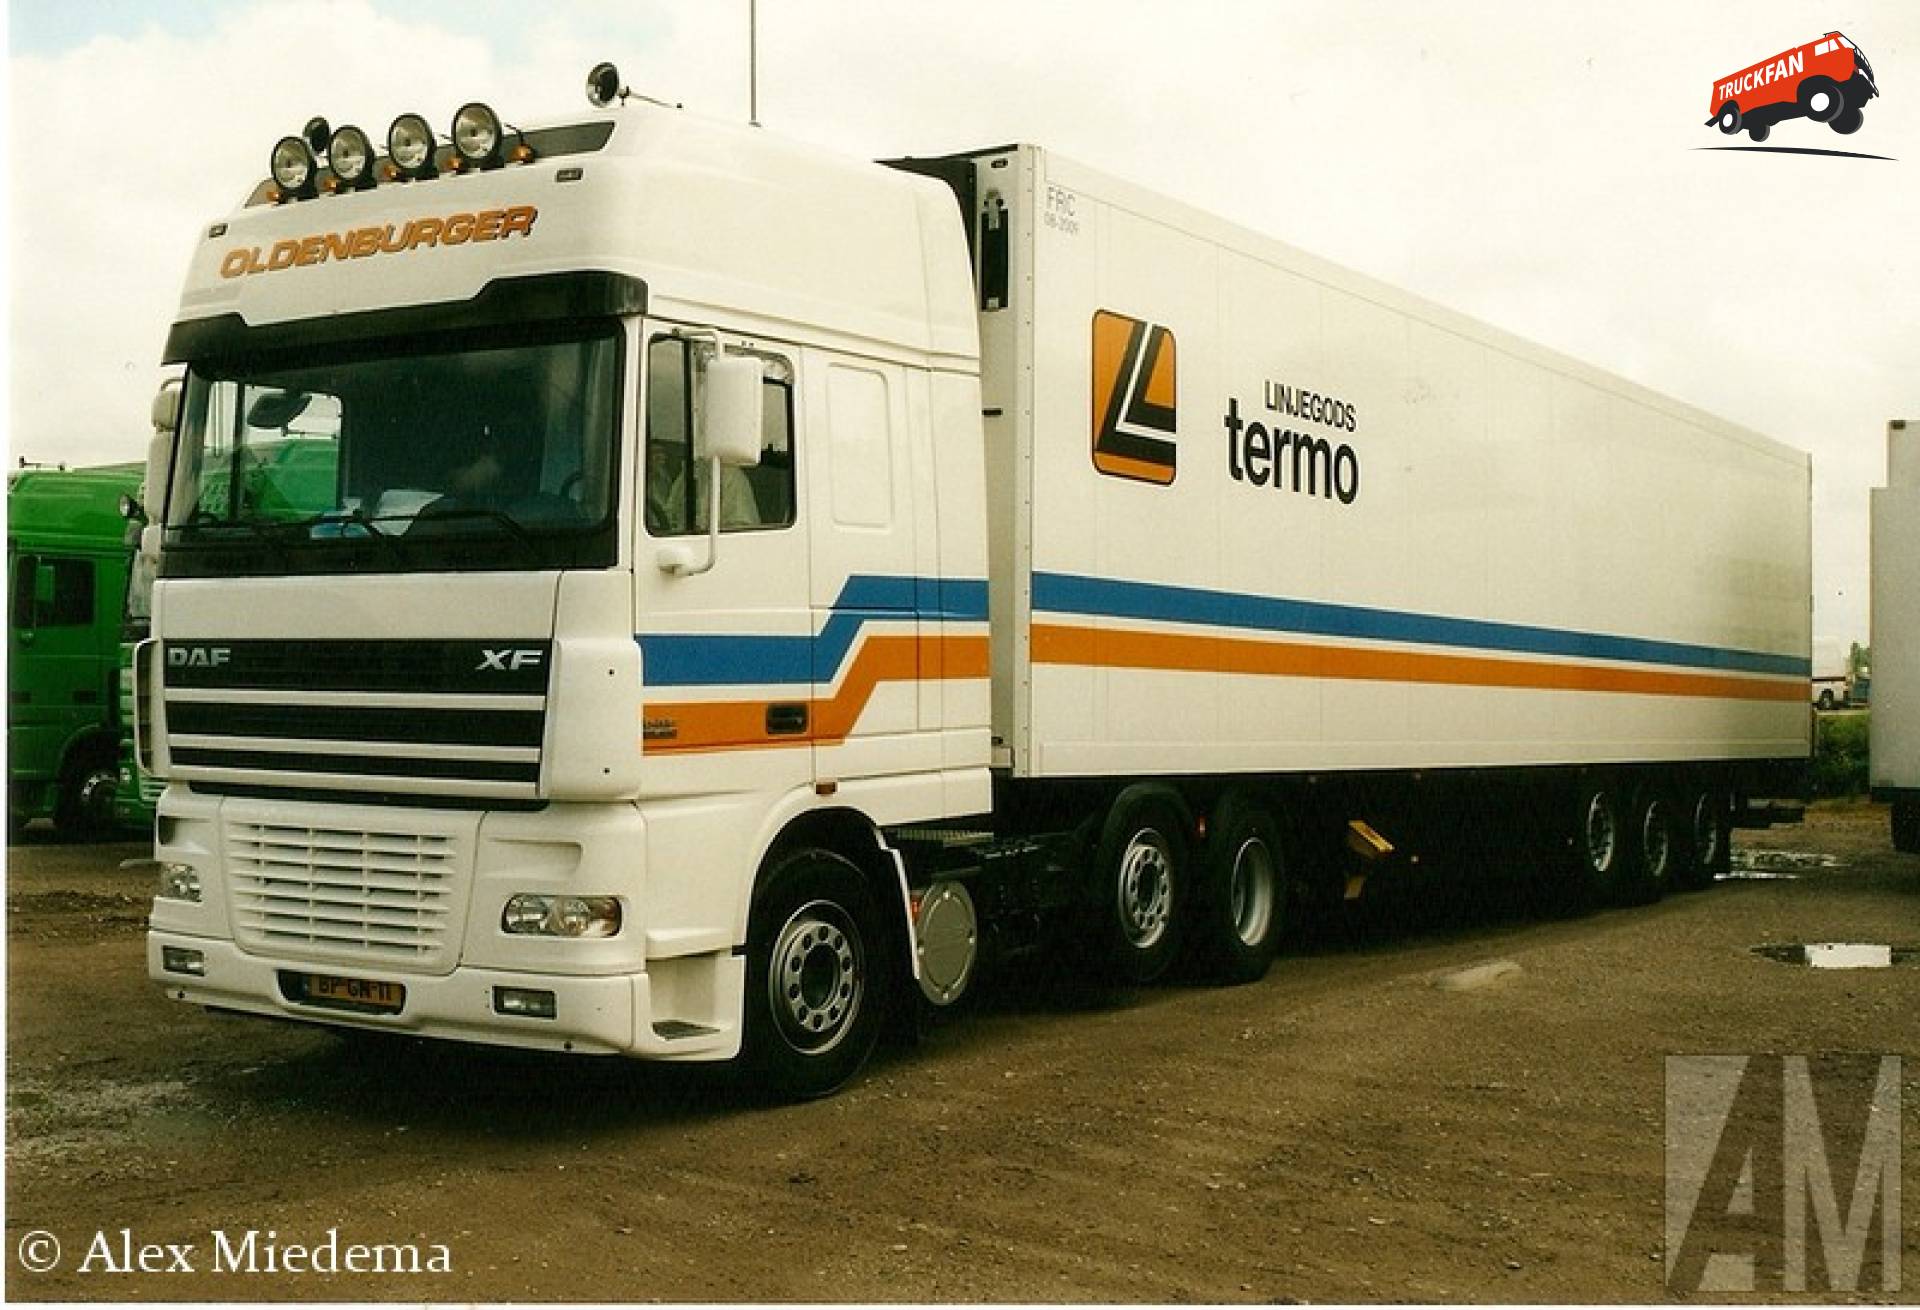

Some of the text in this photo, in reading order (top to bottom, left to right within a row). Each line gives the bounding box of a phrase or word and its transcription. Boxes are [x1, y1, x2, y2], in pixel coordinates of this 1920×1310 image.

[220, 205, 538, 279] OLDENBURGER
[1264, 380, 1356, 432] LINJEGODS
[1224, 397, 1358, 504] termo
[167, 647, 231, 667] DAF
[475, 649, 543, 670] XF
